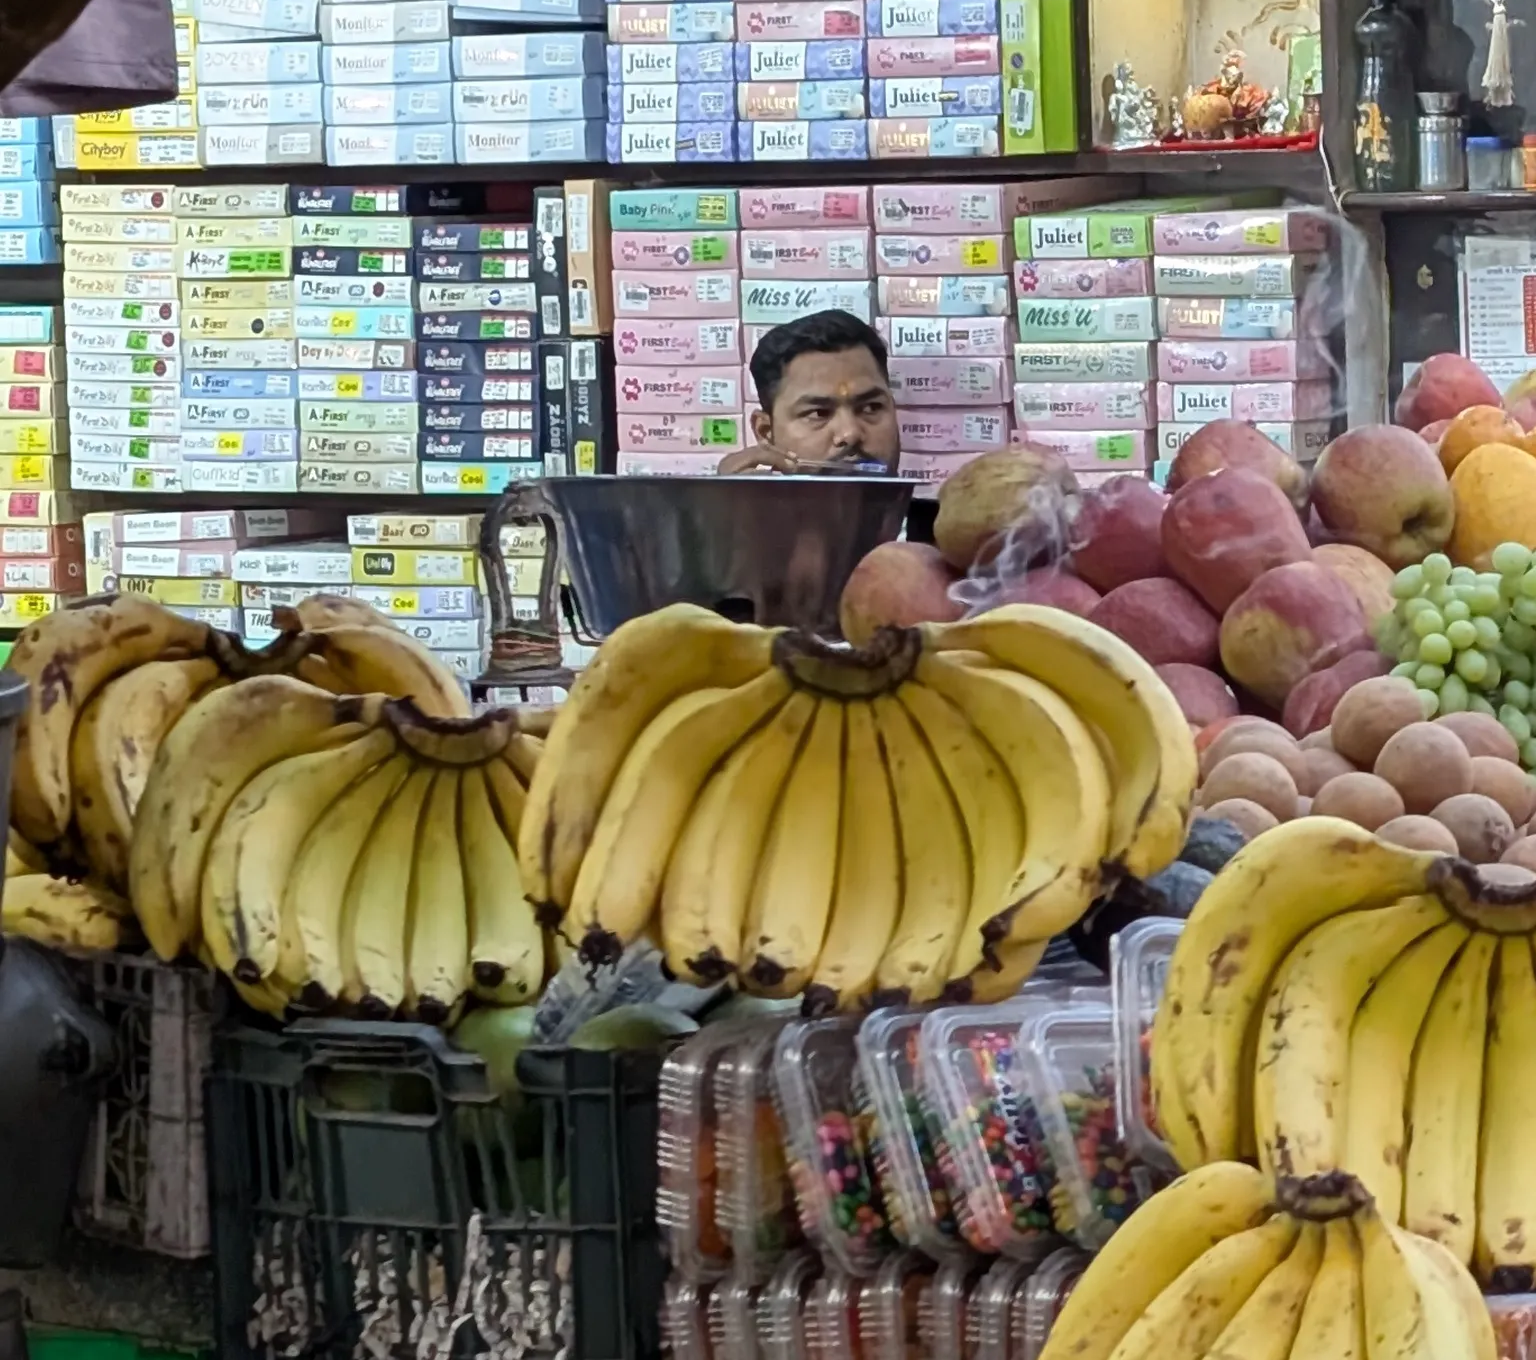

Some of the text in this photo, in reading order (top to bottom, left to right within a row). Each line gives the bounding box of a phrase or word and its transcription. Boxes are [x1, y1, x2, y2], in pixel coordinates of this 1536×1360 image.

[335, 56, 389, 70] Monitor
[627, 52, 672, 74] Juliet
[754, 50, 800, 73] Juliet
[627, 93, 673, 114] Juliet
[467, 133, 522, 148] Monitor
[625, 133, 671, 155] Juliet
[756, 131, 805, 152] Juliet
[619, 202, 648, 218] Baby
[1035, 227, 1083, 249] Juliet
[747, 287, 790, 308] Miss
[1025, 307, 1071, 327] Miss
[642, 338, 671, 348] FIRST
[895, 326, 943, 348] Juliet
[301, 344, 322, 361] Day
[1020, 355, 1063, 366] FIRST
[1178, 392, 1228, 414] Juliet
[902, 423, 932, 434] FIRST
[127, 578, 155, 595] 007
[393, 597, 416, 610] Cool
